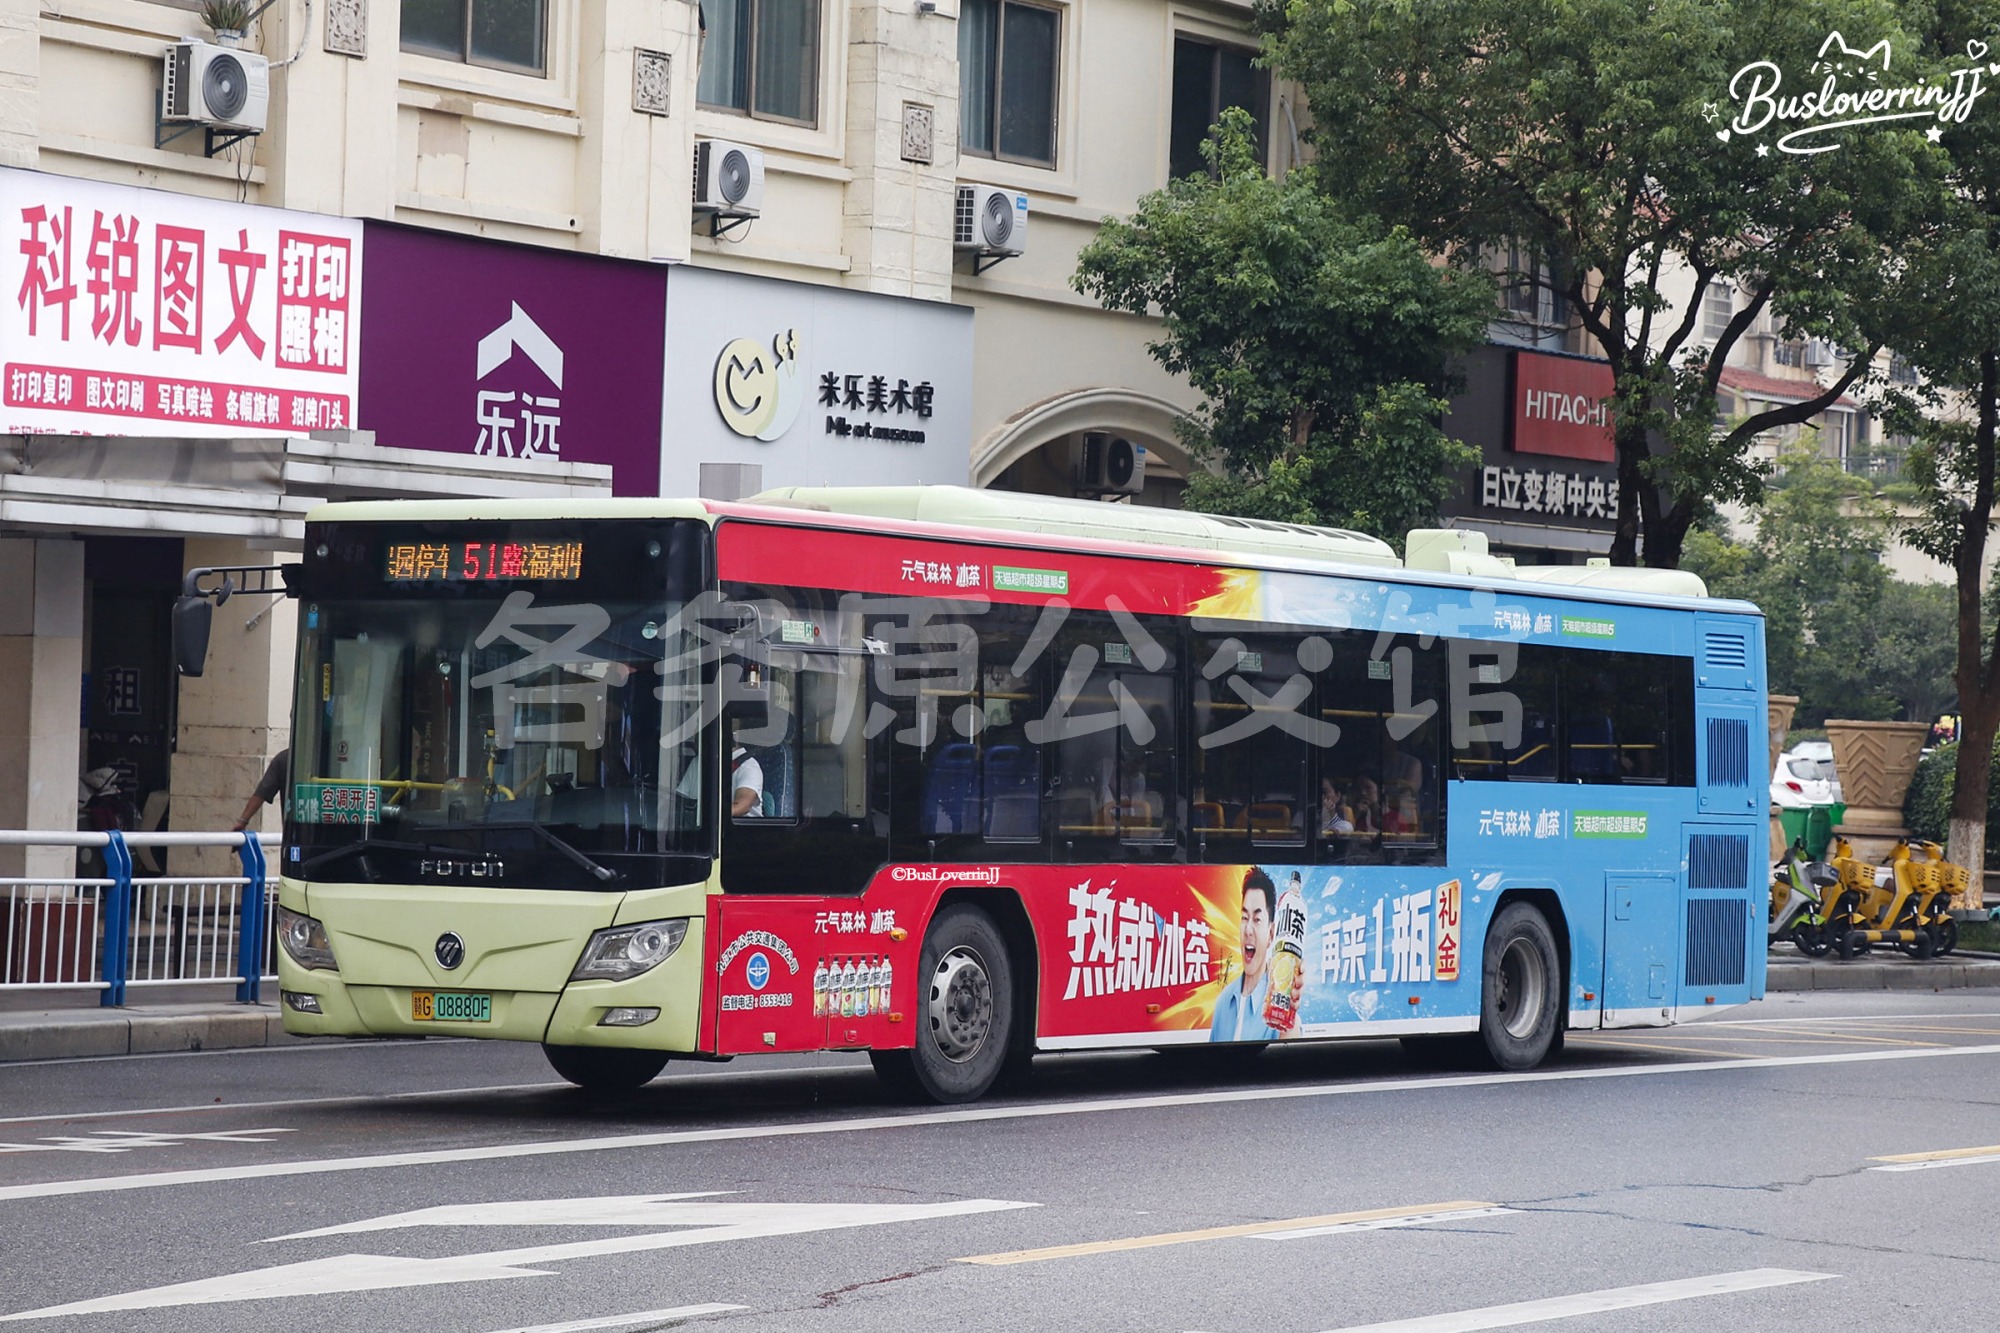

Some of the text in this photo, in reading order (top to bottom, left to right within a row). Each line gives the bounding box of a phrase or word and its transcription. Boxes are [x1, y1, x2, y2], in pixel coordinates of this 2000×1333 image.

[18, 204, 267, 361] 科锐图文
[282, 239, 347, 302] 打印
[280, 304, 345, 367] 照相
[12, 369, 344, 429] 打印复印 图文印刷 写真喷绘 条幅旗帜 招牌门头
[818, 371, 934, 418] 米乐美术馆
[1526, 389, 1607, 427] HITACHI
[474, 390, 561, 461] 乐远
[1482, 465, 1642, 524] 日立变频中央空
[901, 560, 952, 584] 元气森林
[955, 562, 981, 587] 冰茶
[321, 787, 377, 811] 空调开启
[1479, 809, 1532, 837] 元气森林
[1534, 808, 1560, 839] 冰茶
[420, 859, 504, 878] FOTON
[815, 911, 867, 934] 元气森林
[1320, 889, 1432, 985] 再来1瓶
[1438, 888, 1458, 974] 礼金
